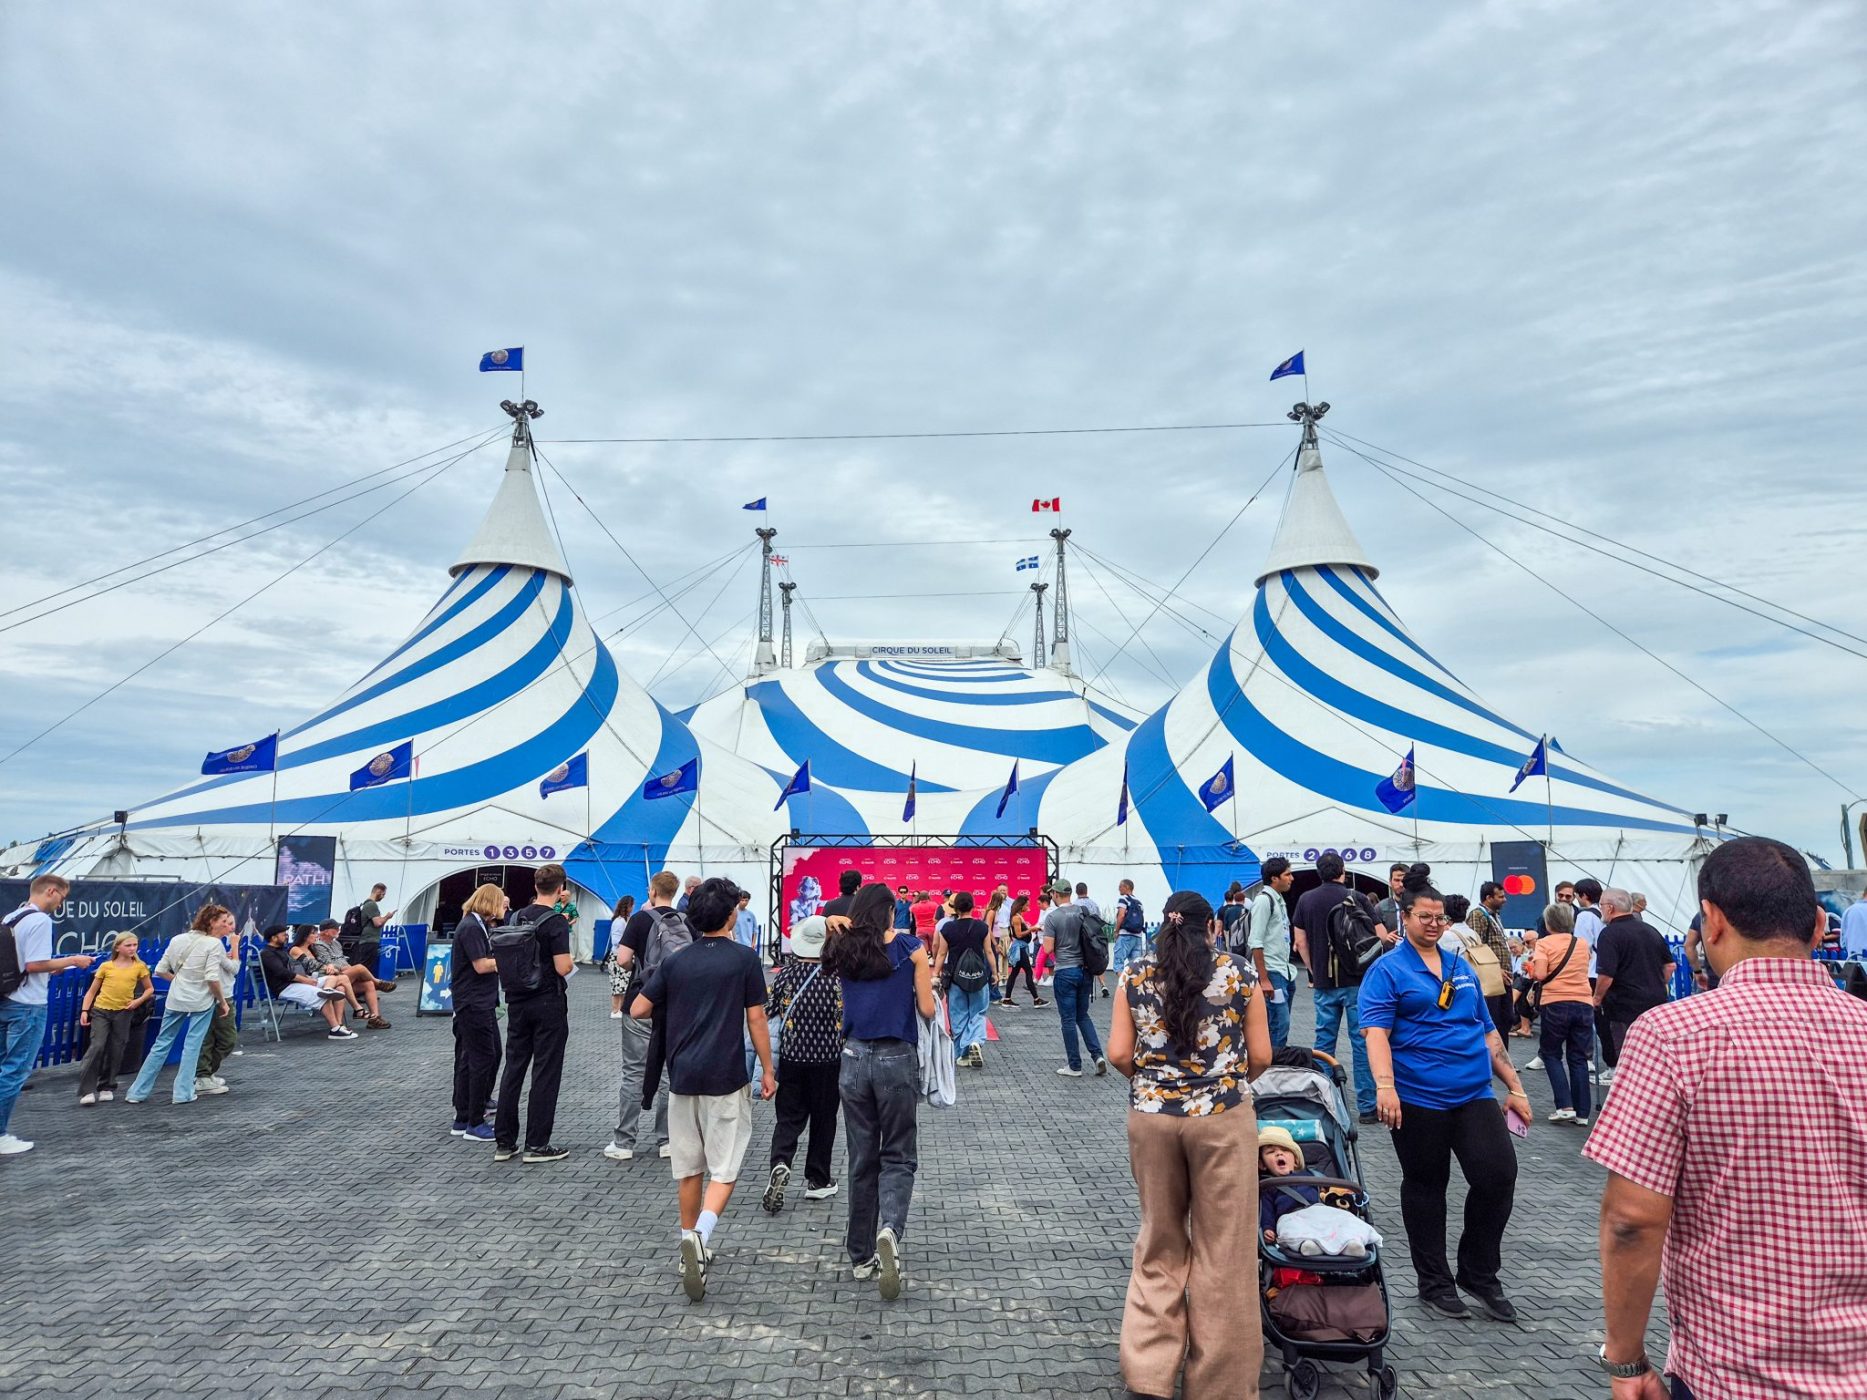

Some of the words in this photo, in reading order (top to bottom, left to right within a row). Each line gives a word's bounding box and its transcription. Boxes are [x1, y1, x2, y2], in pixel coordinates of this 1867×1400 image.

[872, 646, 905, 655] CIRQUE
[907, 646, 920, 654] DU
[922, 646, 952, 654] SOLEIL
[444, 848, 480, 856] PORTES
[283, 874, 326, 885] PATH
[78, 901, 99, 918] DU
[103, 901, 146, 918] SOLEIL
